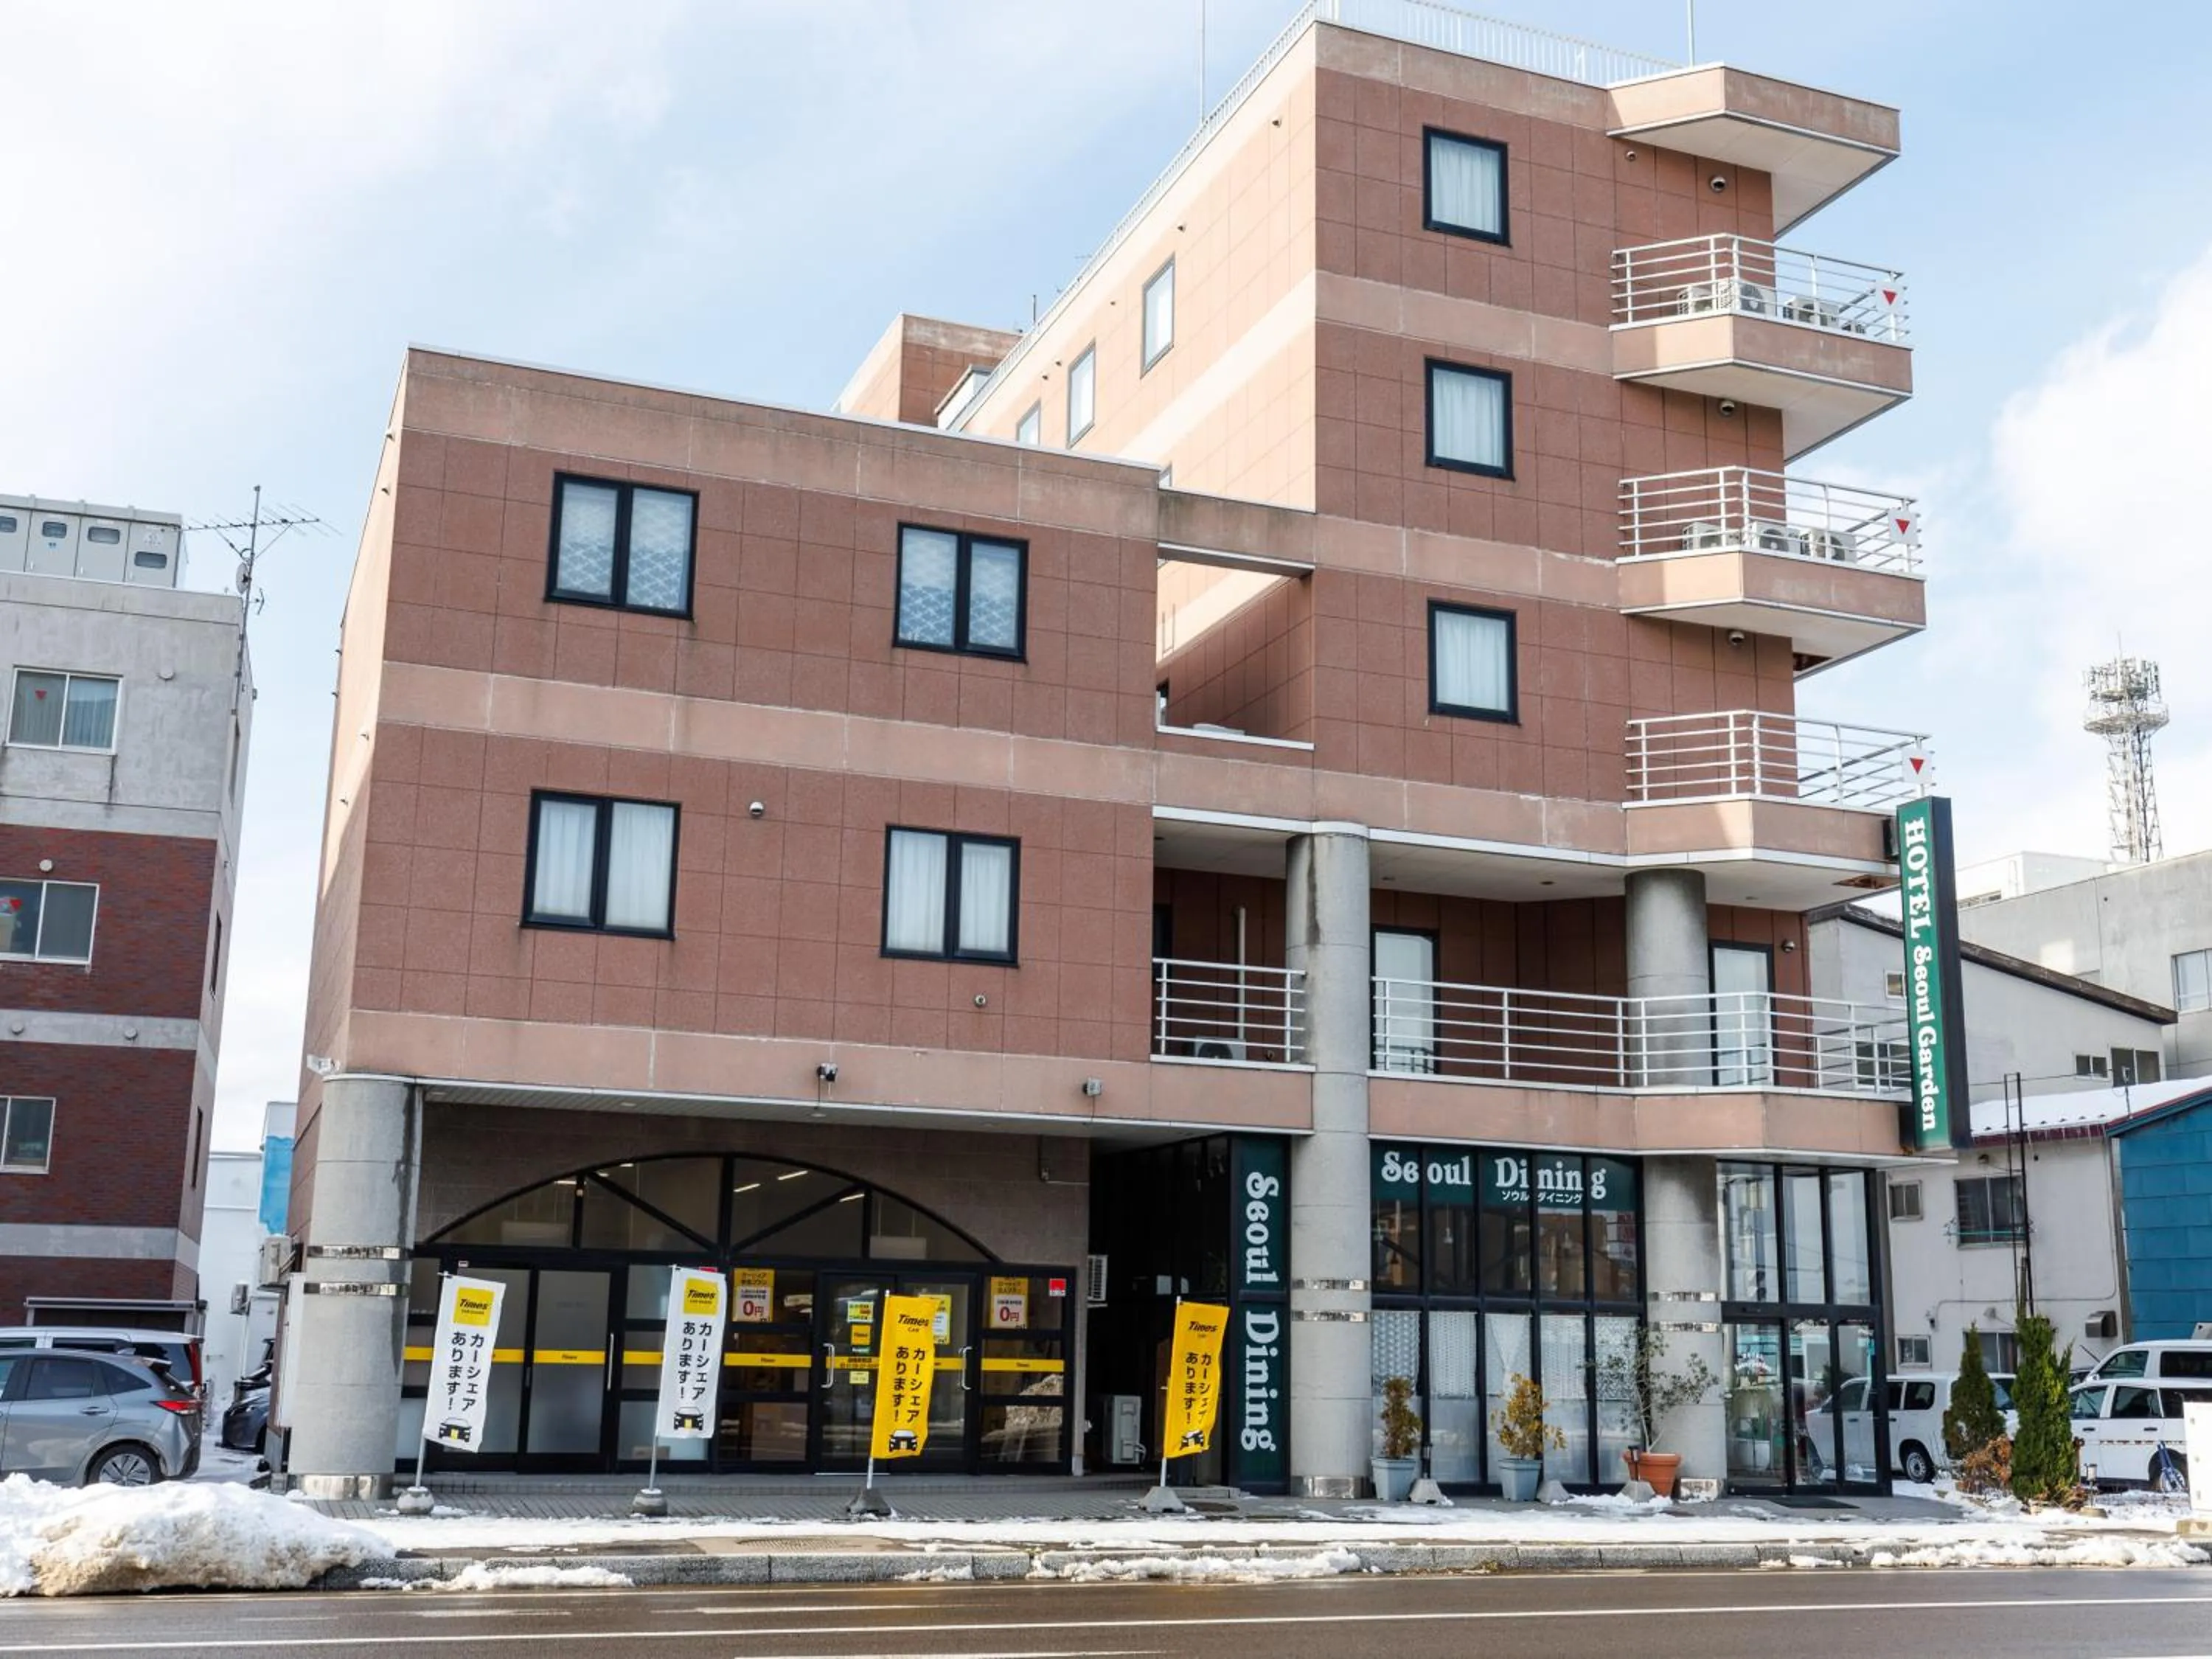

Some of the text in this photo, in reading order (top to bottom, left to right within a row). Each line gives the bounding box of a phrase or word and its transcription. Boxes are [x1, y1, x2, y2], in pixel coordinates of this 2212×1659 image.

[1905, 816, 1940, 1132] HOTEL Seoul Garden
[1381, 1151, 1607, 1200] Seoul Dining
[459, 1298, 488, 1310] Times
[687, 1289, 716, 1300] Times
[742, 1300, 765, 1317] 0円
[898, 1314, 929, 1326] Times
[1000, 1307, 1020, 1322] 0円
[1189, 1321, 1218, 1332] Times
[1239, 1171, 1280, 1452] Seoul Dining
[462, 1333, 484, 1412] カーシェア
[692, 1322, 712, 1400] カーシェア
[906, 1347, 925, 1423] カーシェア
